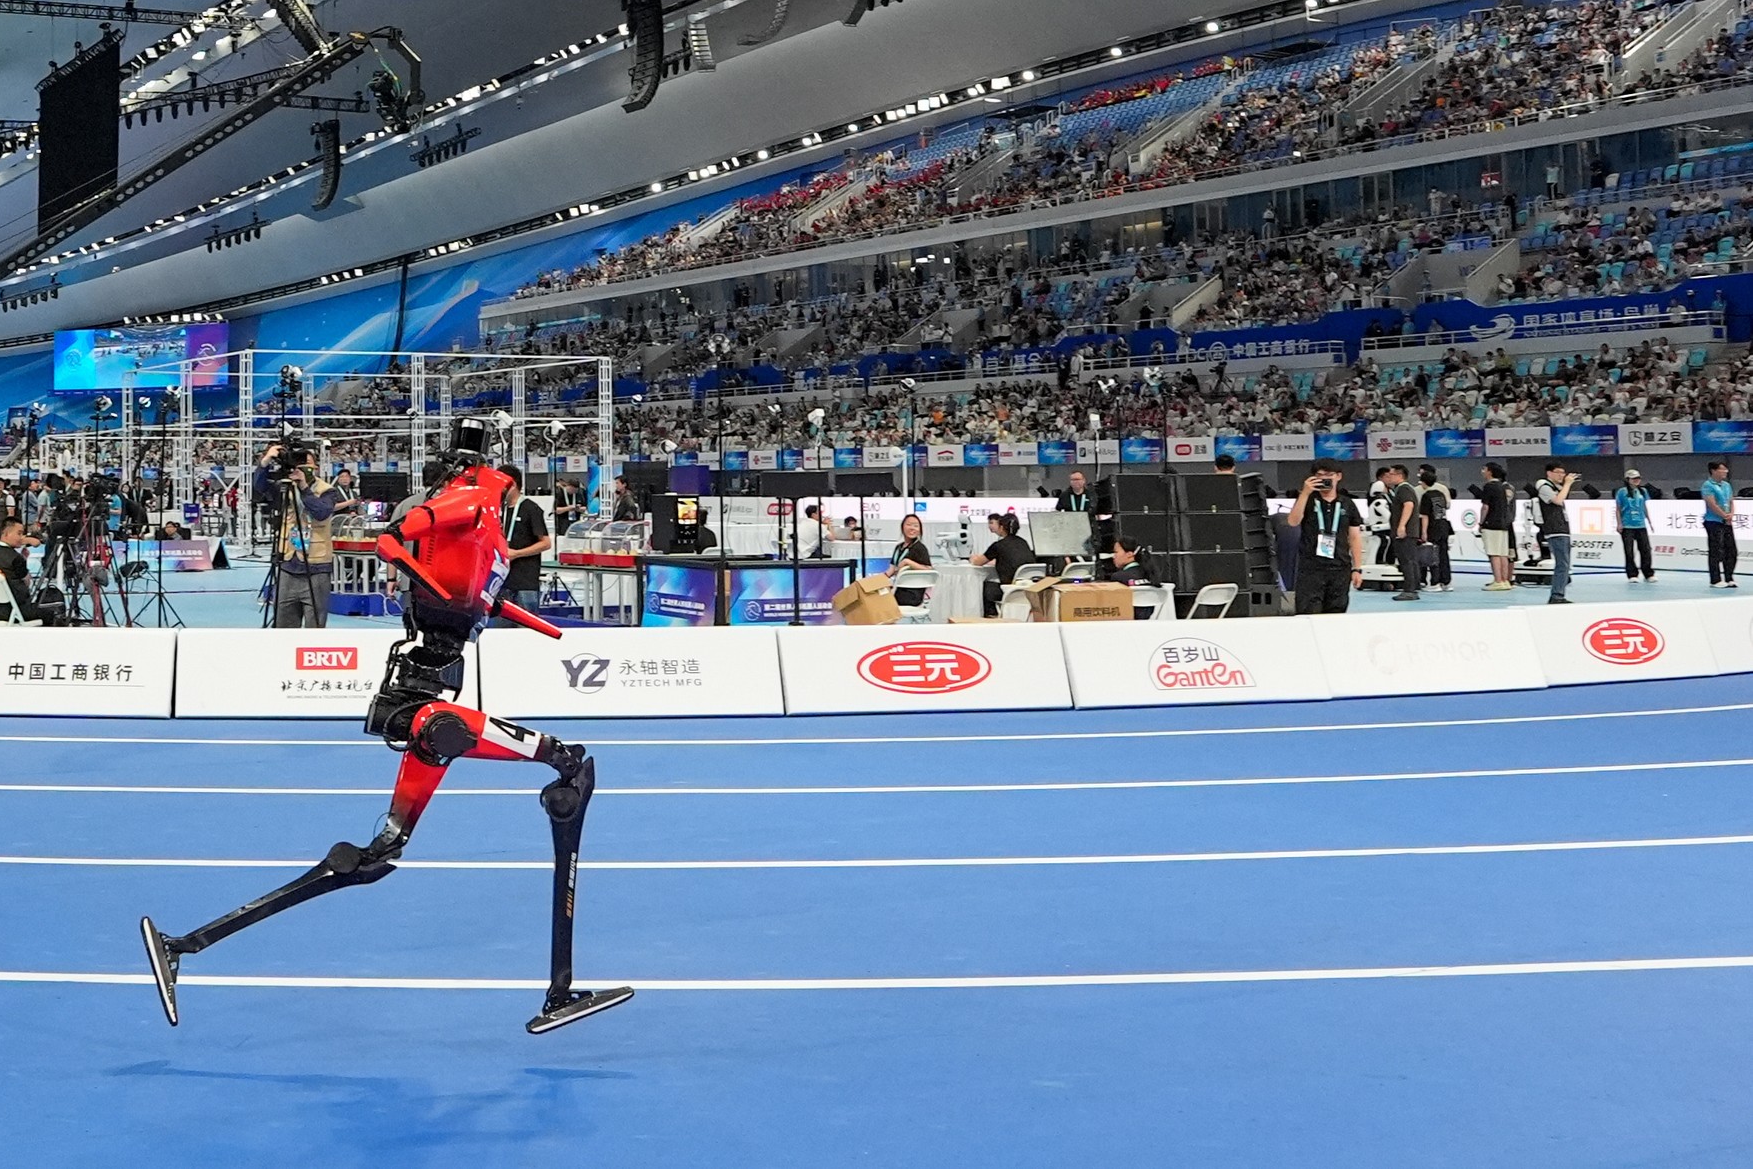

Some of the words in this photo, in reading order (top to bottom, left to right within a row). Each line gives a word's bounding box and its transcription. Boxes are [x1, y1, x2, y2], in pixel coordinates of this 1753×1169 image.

[1600, 628, 1649, 655] 三元
[303, 651, 353, 667] BRTV
[1162, 646, 1220, 664] 百岁山
[8, 663, 133, 682] 中国工商银行
[560, 659, 611, 688] YZ
[619, 659, 701, 675] 永轴智造
[889, 653, 962, 683] 三元
[621, 678, 670, 687] YZTECH
[676, 678, 703, 686] MFG
